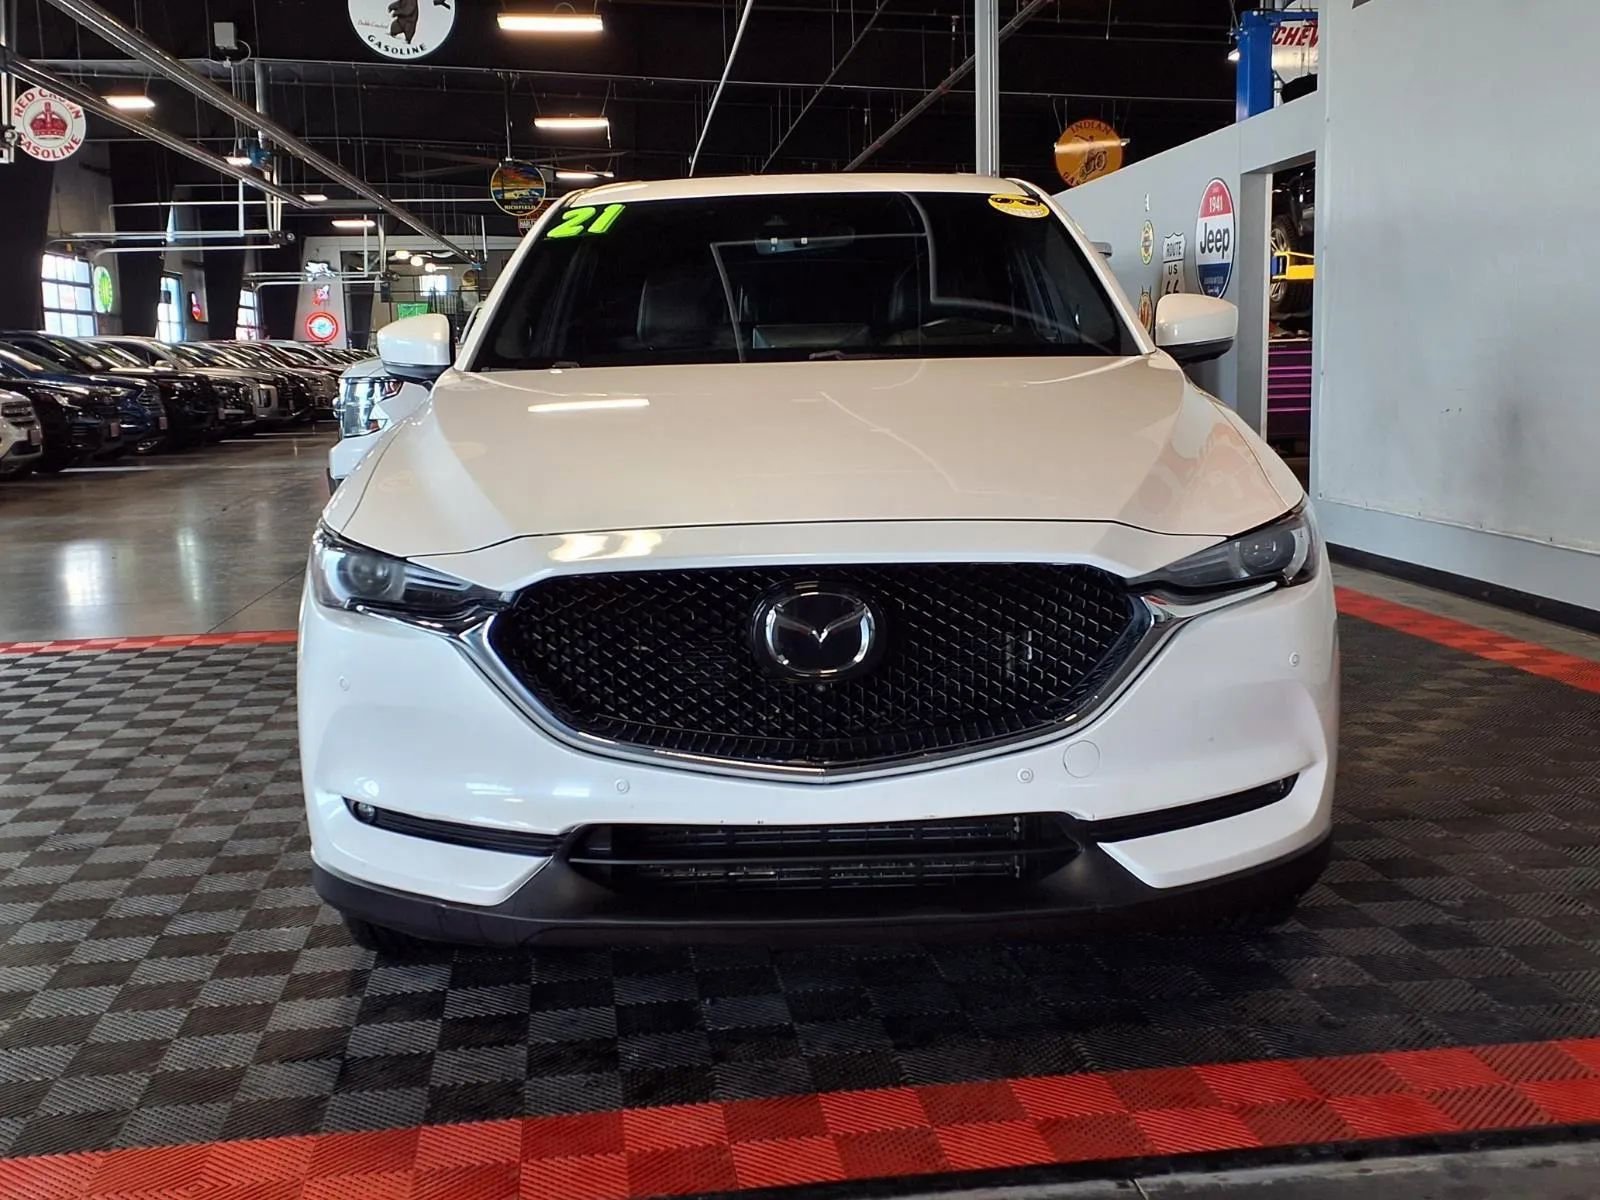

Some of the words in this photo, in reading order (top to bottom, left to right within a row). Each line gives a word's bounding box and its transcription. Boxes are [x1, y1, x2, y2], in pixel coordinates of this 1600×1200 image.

[367, 34, 427, 56] GASOLINE
[14, 91, 36, 118] RED
[1070, 121, 1113, 136] INDIAN
[1209, 193, 1224, 213] 1941
[546, 203, 626, 238] 21
[1199, 222, 1231, 260] Jeep
[1168, 264, 1178, 276] US
